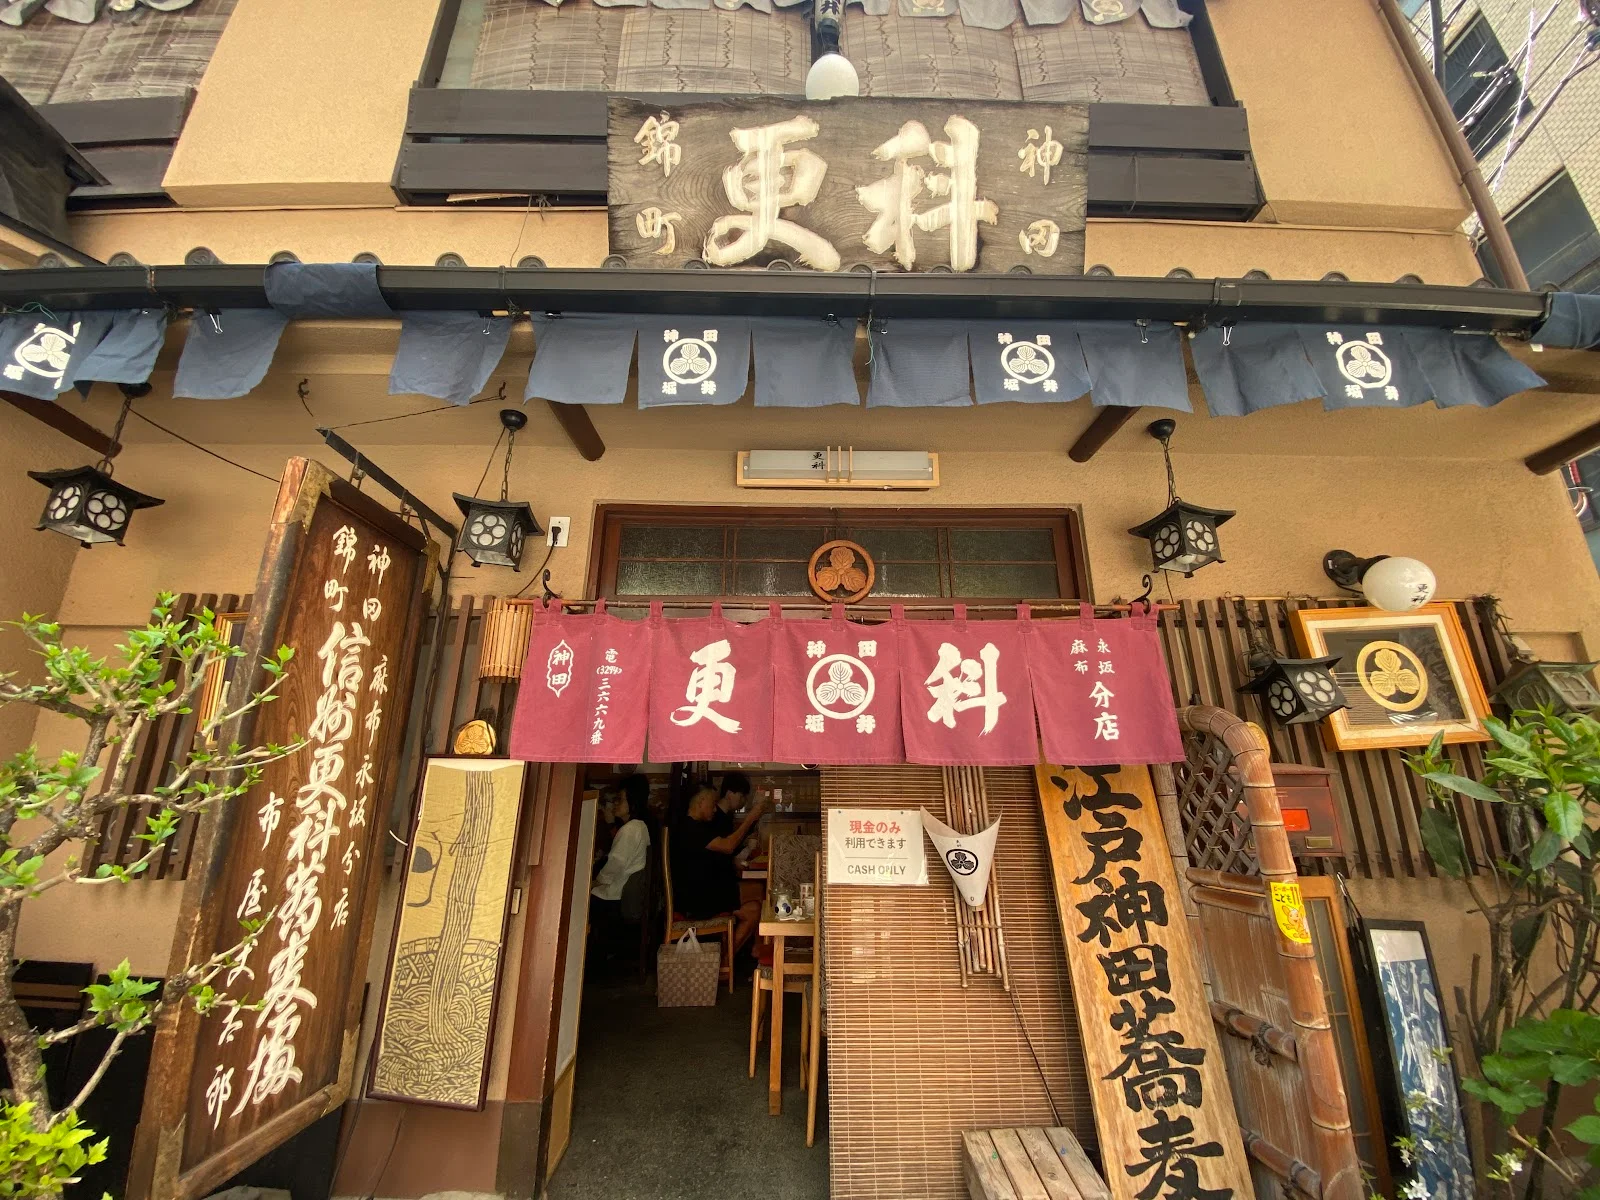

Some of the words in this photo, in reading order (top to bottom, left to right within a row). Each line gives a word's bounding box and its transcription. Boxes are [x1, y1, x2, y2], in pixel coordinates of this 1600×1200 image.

[702, 114, 999, 271] 更科
[811, 451, 825, 470] 更科
[1070, 639, 1089, 674] 麻布
[551, 649, 570, 685] 神田
[849, 820, 901, 834] 現金のみ
[845, 837, 907, 849] 利用できます
[847, 864, 876, 875] CASH
[878, 865, 906, 875] ONLY
